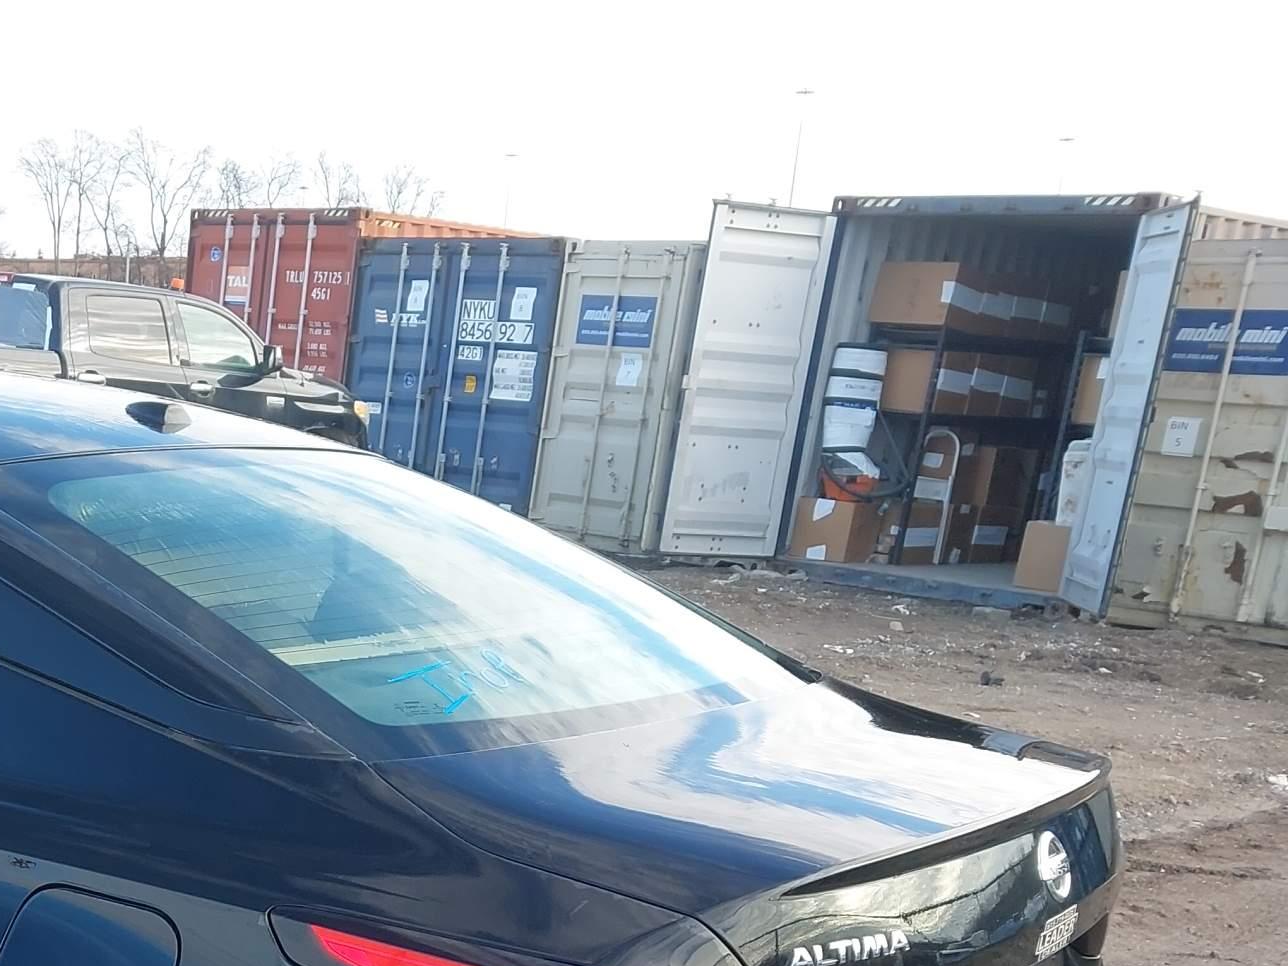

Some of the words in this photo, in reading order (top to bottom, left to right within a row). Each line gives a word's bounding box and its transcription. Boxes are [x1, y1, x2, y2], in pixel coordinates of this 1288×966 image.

[227, 275, 249, 288] TAL
[285, 270, 305, 283] TRLU
[313, 271, 342, 284] 757125
[311, 287, 330, 301] 45G1
[462, 300, 496, 320] NYKU
[622, 308, 653, 323] mini
[1240, 326, 1288, 344] mini
[1170, 420, 1189, 431] BIN
[1039, 918, 1075, 950] LEADER
